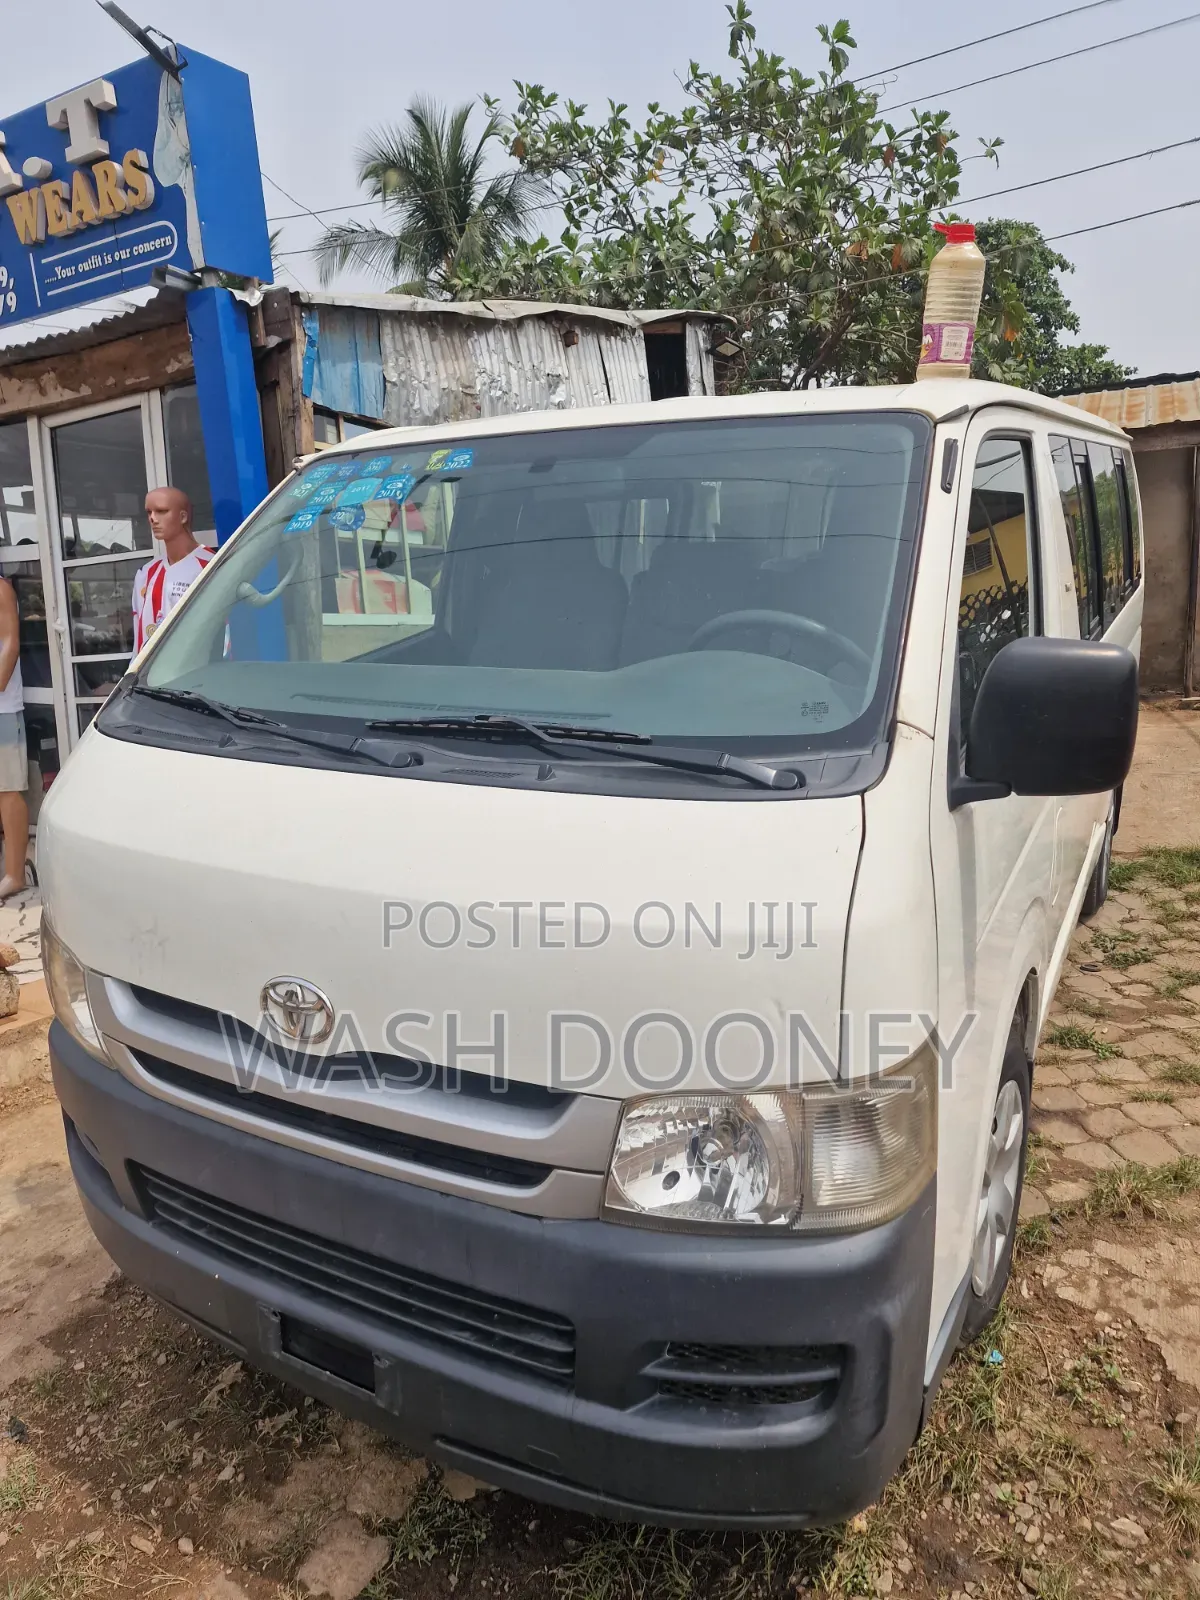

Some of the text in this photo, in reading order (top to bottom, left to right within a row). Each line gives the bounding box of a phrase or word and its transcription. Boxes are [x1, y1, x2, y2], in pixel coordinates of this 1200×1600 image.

[6, 148, 155, 245] WEARS
[78, 255, 103, 273] outfit
[103, 252, 113, 264] is
[114, 247, 131, 261] our
[132, 235, 173, 256] concern
[289, 520, 312, 530] 2019
